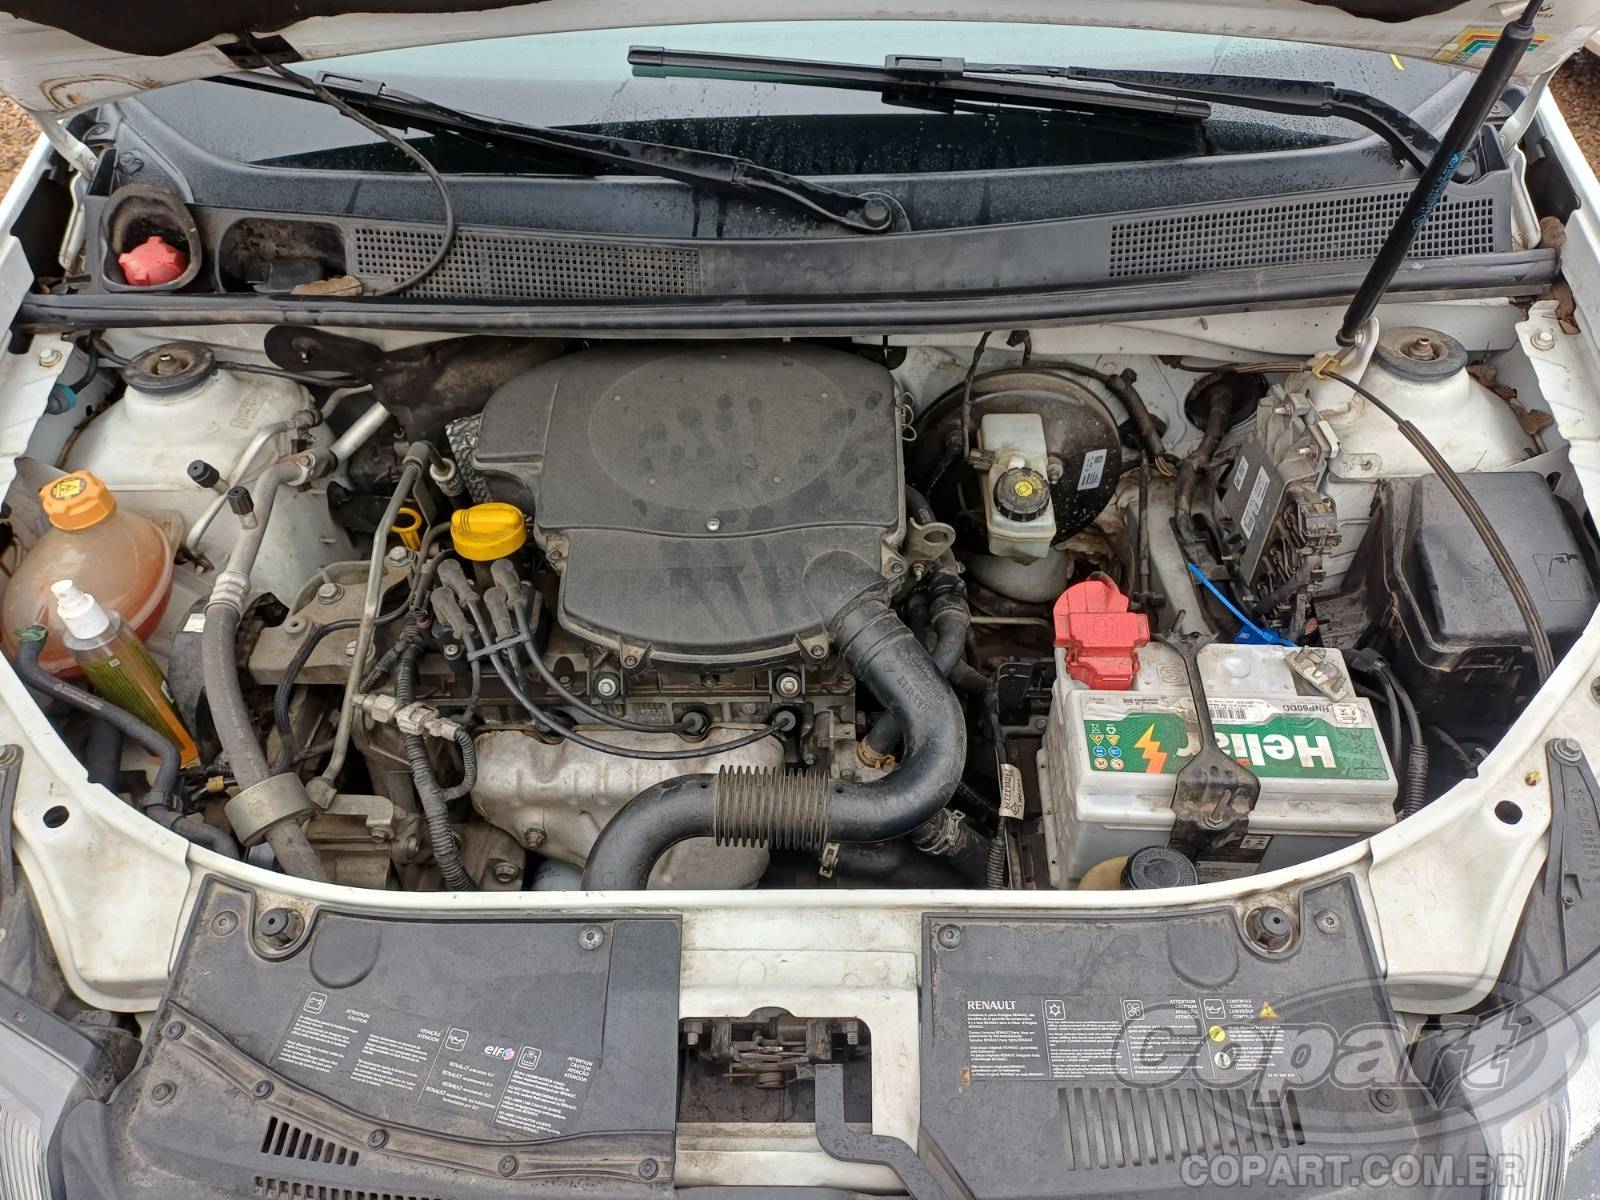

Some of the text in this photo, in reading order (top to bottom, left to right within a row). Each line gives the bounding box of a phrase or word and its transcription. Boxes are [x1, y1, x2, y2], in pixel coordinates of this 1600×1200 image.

[1283, 703, 1330, 714] HNP60DD
[967, 1000, 1016, 1010] RENAULT
[484, 1045, 504, 1057] elf
[567, 1056, 593, 1067] ATTENTION
